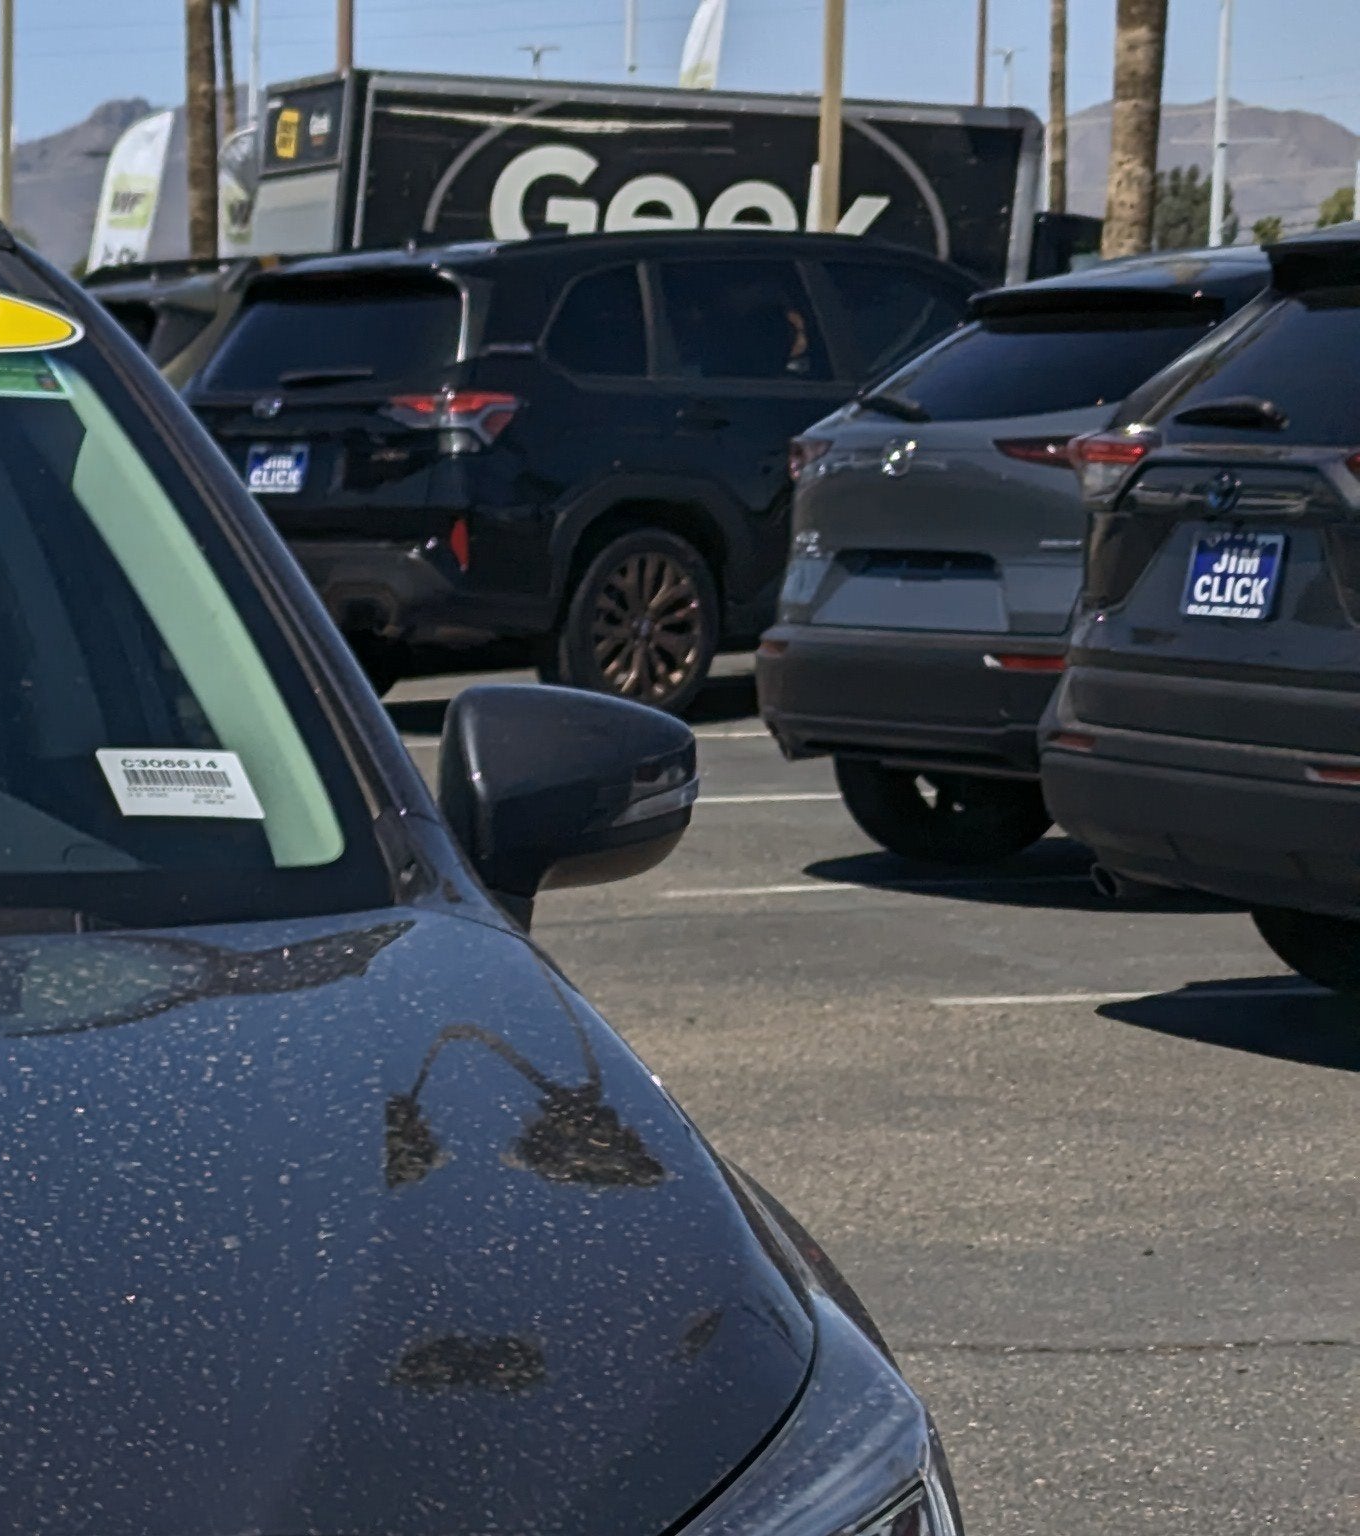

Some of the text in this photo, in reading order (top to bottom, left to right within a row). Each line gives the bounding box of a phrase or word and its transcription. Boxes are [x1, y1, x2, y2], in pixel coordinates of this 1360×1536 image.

[249, 470, 302, 486] CLICK
[1212, 547, 1261, 575] JIM
[1193, 574, 1270, 605] CLICK
